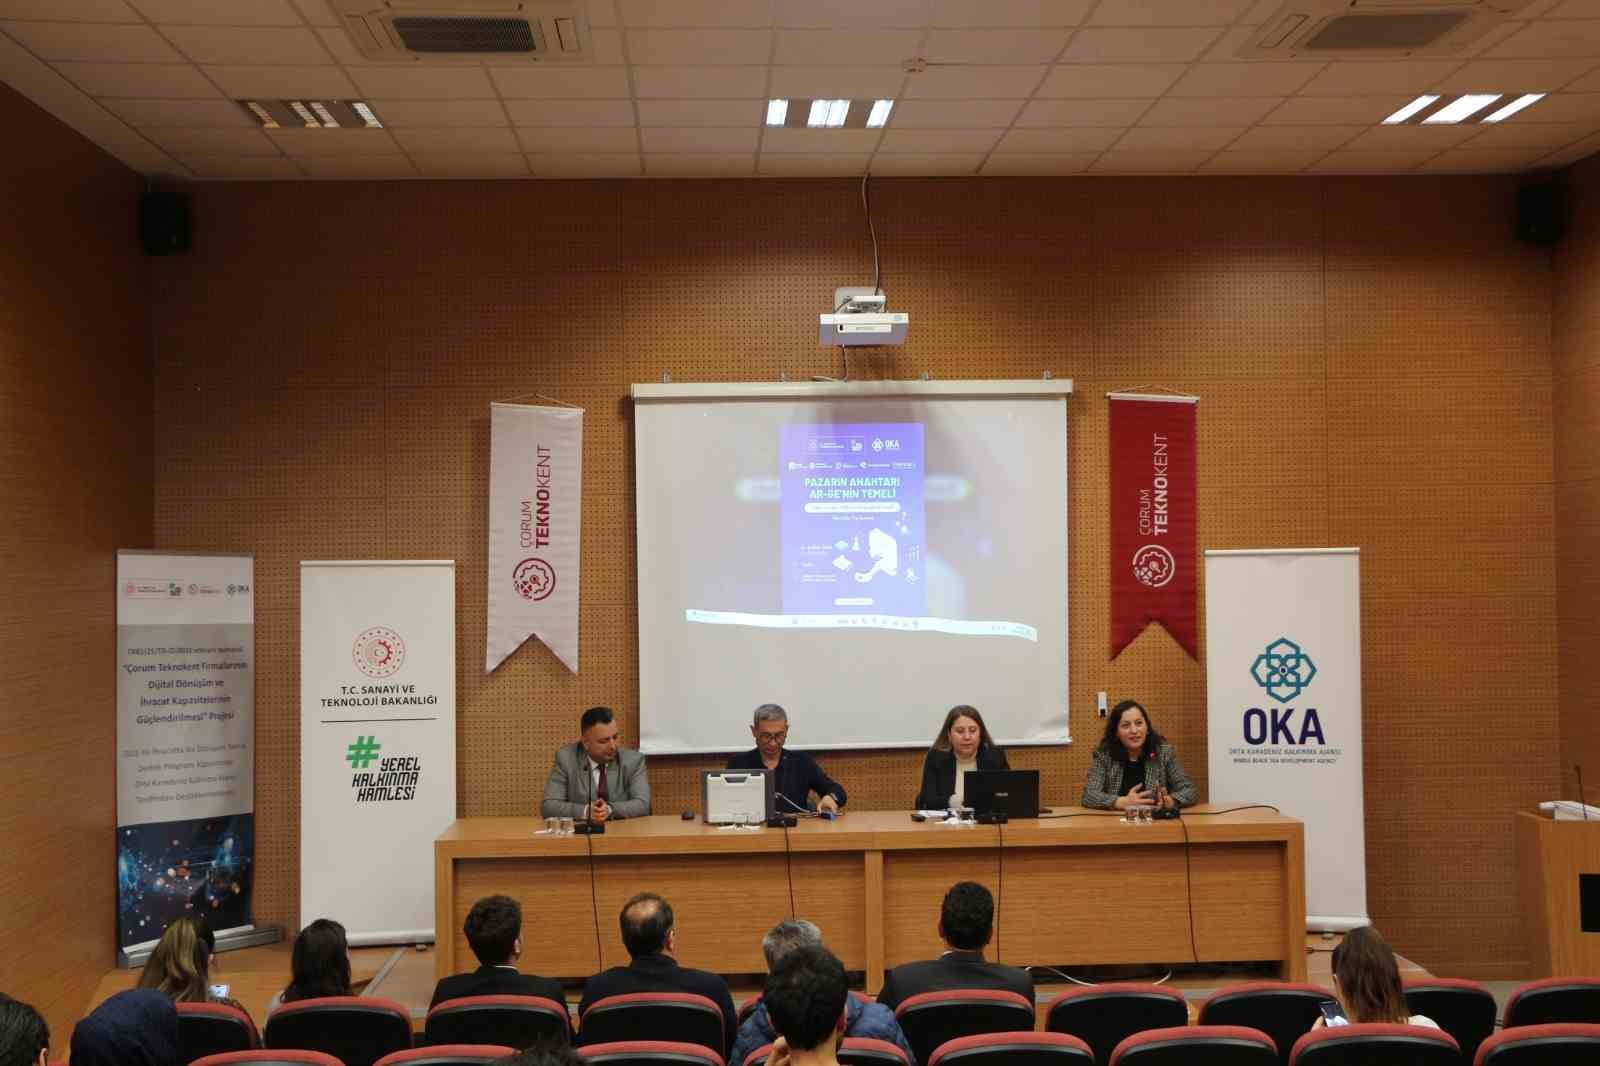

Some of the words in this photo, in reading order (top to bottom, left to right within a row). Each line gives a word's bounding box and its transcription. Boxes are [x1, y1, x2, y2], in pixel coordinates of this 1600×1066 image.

[536, 444, 551, 549] TEKNOKENT
[1153, 433, 1168, 536] TEKNOKENT
[520, 501, 532, 549] ÇORUM
[1139, 489, 1153, 536] ÇORUM
[320, 696, 378, 707] TEKNOLOJİ
[381, 695, 438, 706] BAKANLIĞI
[341, 686, 360, 695] T.C.
[361, 684, 400, 694] SANAYİ
[402, 684, 416, 694] VE
[1243, 708, 1326, 746] OKA
[352, 771, 419, 788] KALKINMA
